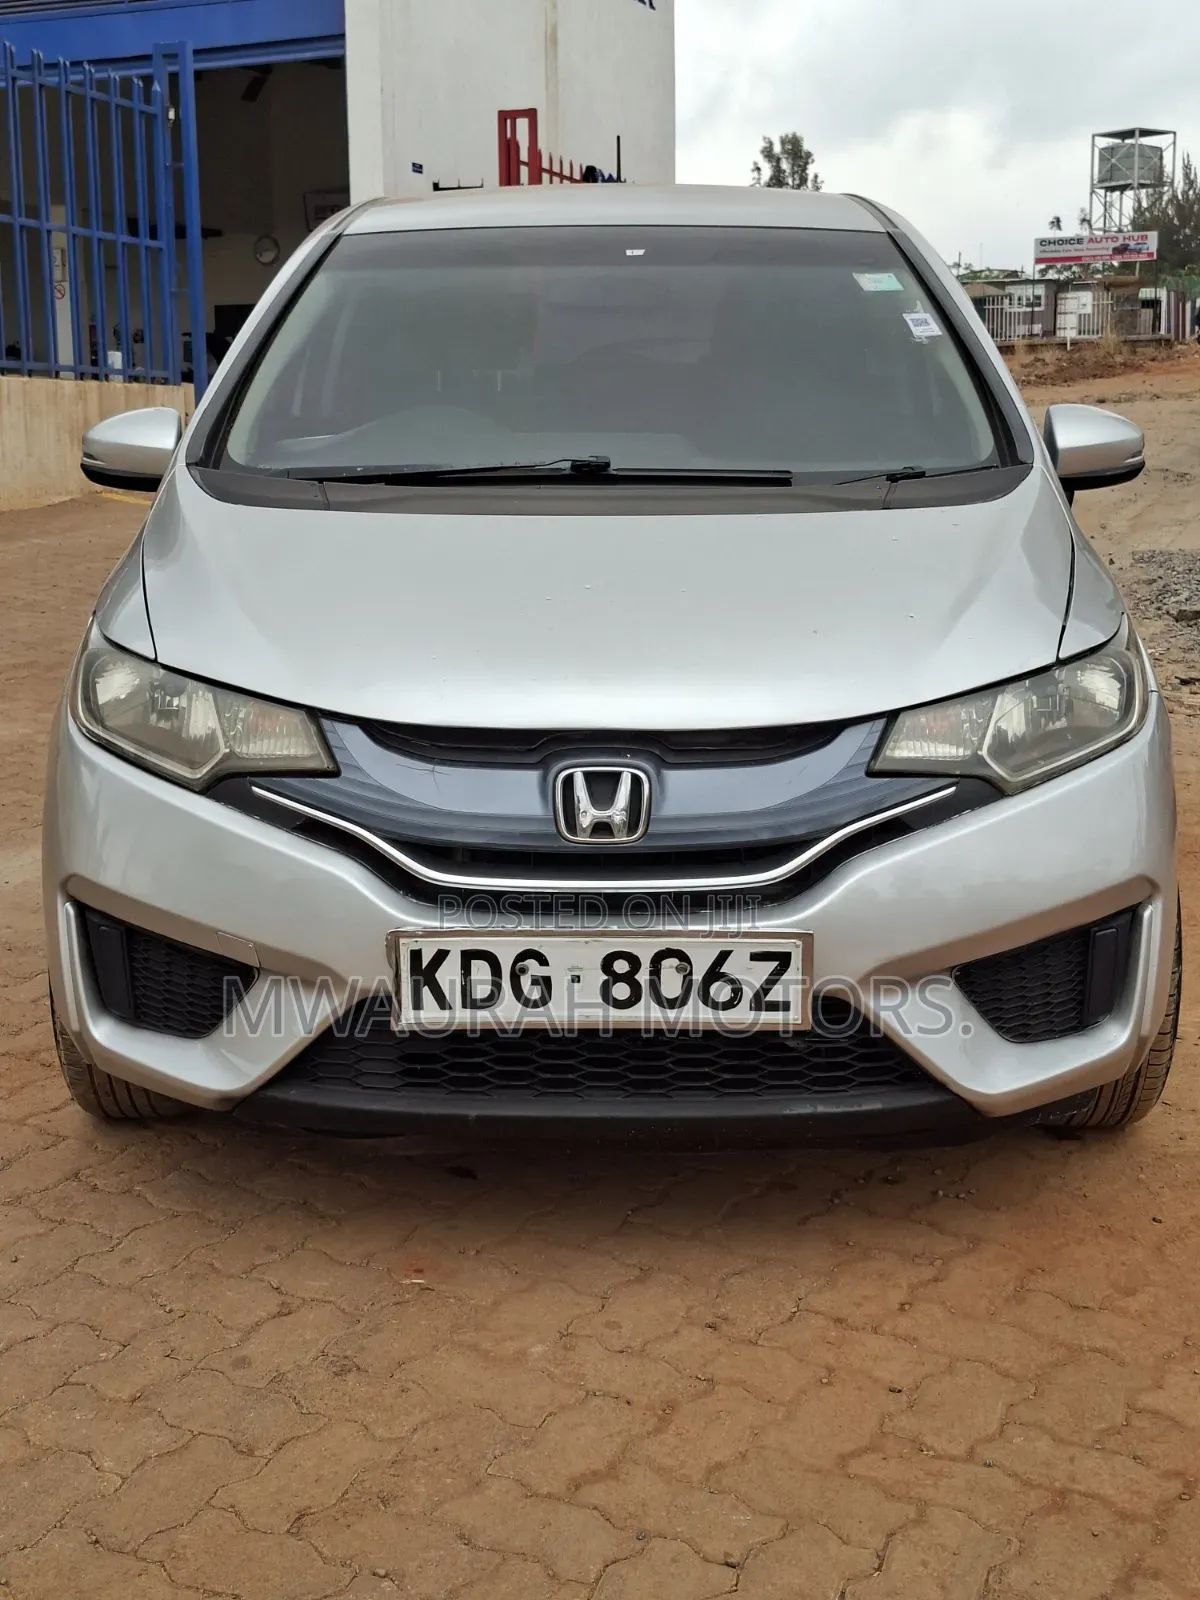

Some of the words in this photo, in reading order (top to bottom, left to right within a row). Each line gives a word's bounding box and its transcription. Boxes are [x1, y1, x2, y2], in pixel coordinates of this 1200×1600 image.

[1040, 238, 1084, 247] CHOICE
[1087, 236, 1119, 244] AUTO
[1123, 234, 1148, 242] HUB
[409, 948, 553, 1011] KDG
[600, 947, 793, 1012] 806Z
